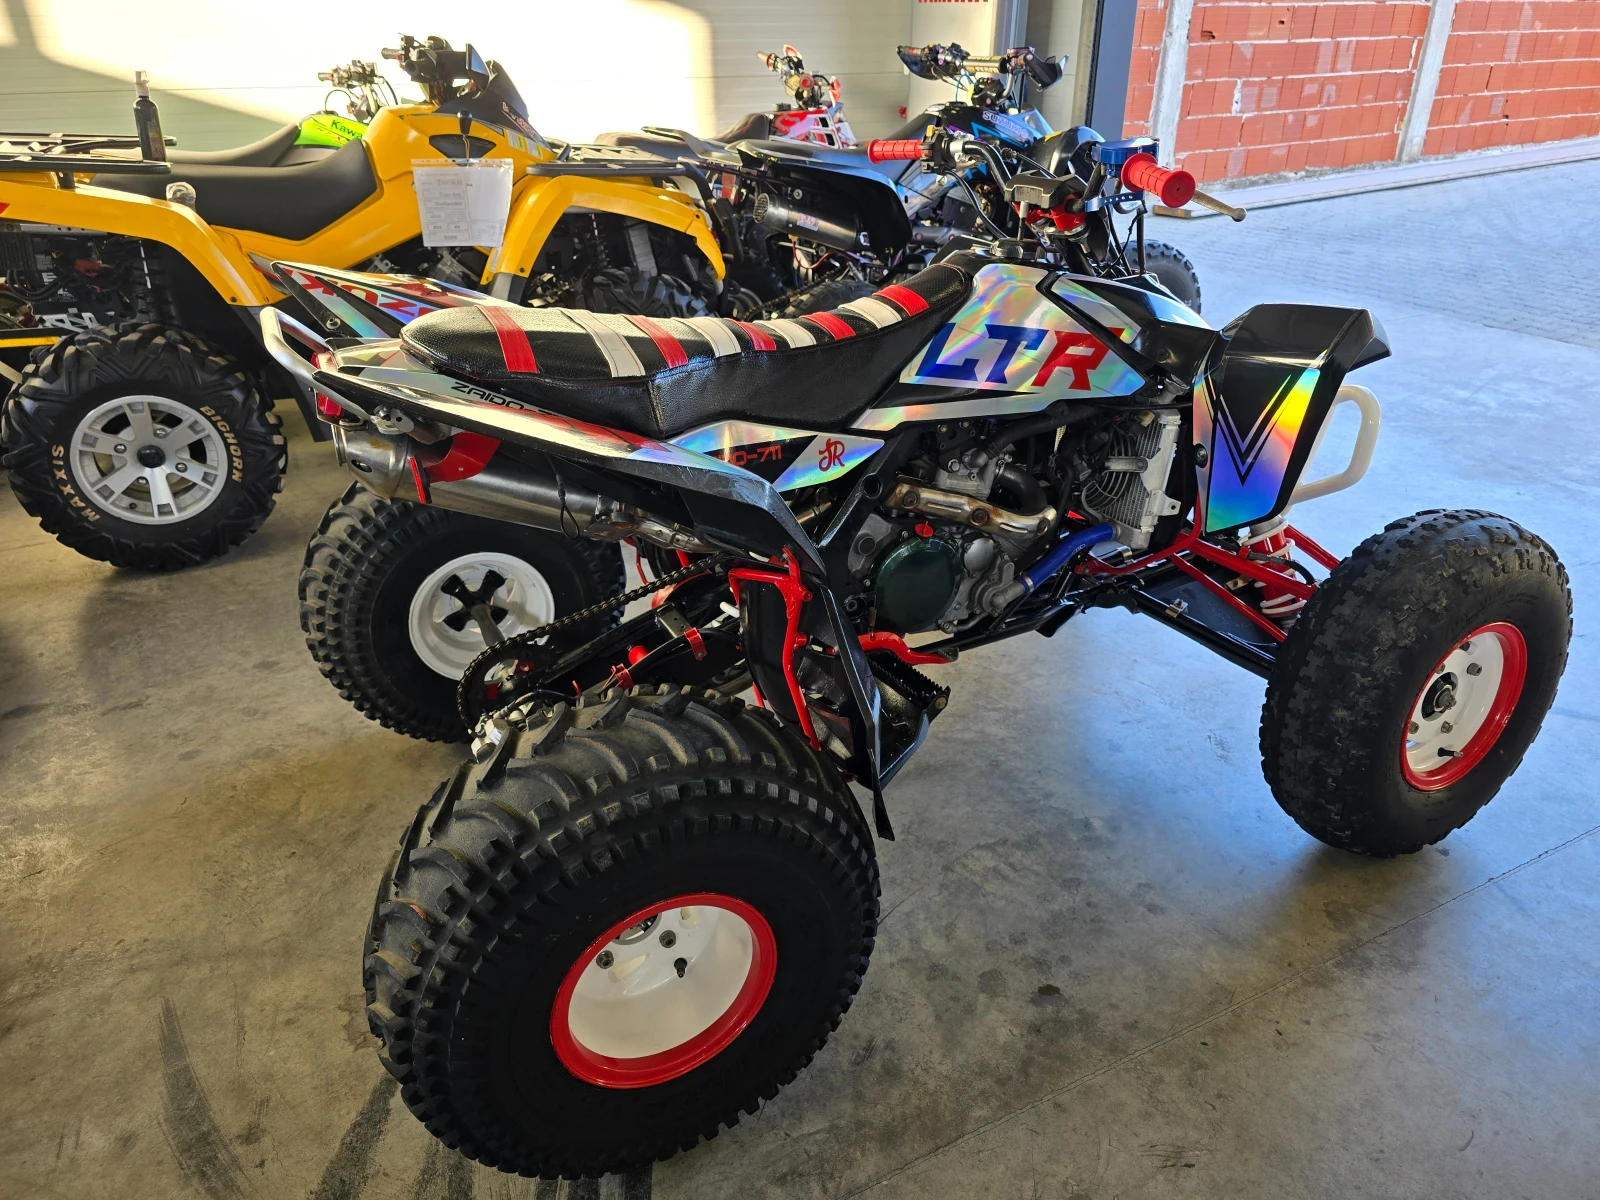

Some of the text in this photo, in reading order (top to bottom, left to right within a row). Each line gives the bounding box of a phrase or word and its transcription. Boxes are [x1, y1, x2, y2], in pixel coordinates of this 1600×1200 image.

[915, 322, 1126, 391] LTR
[200, 405, 243, 482] BIGHORN
[51, 443, 100, 522] MAXXIS
